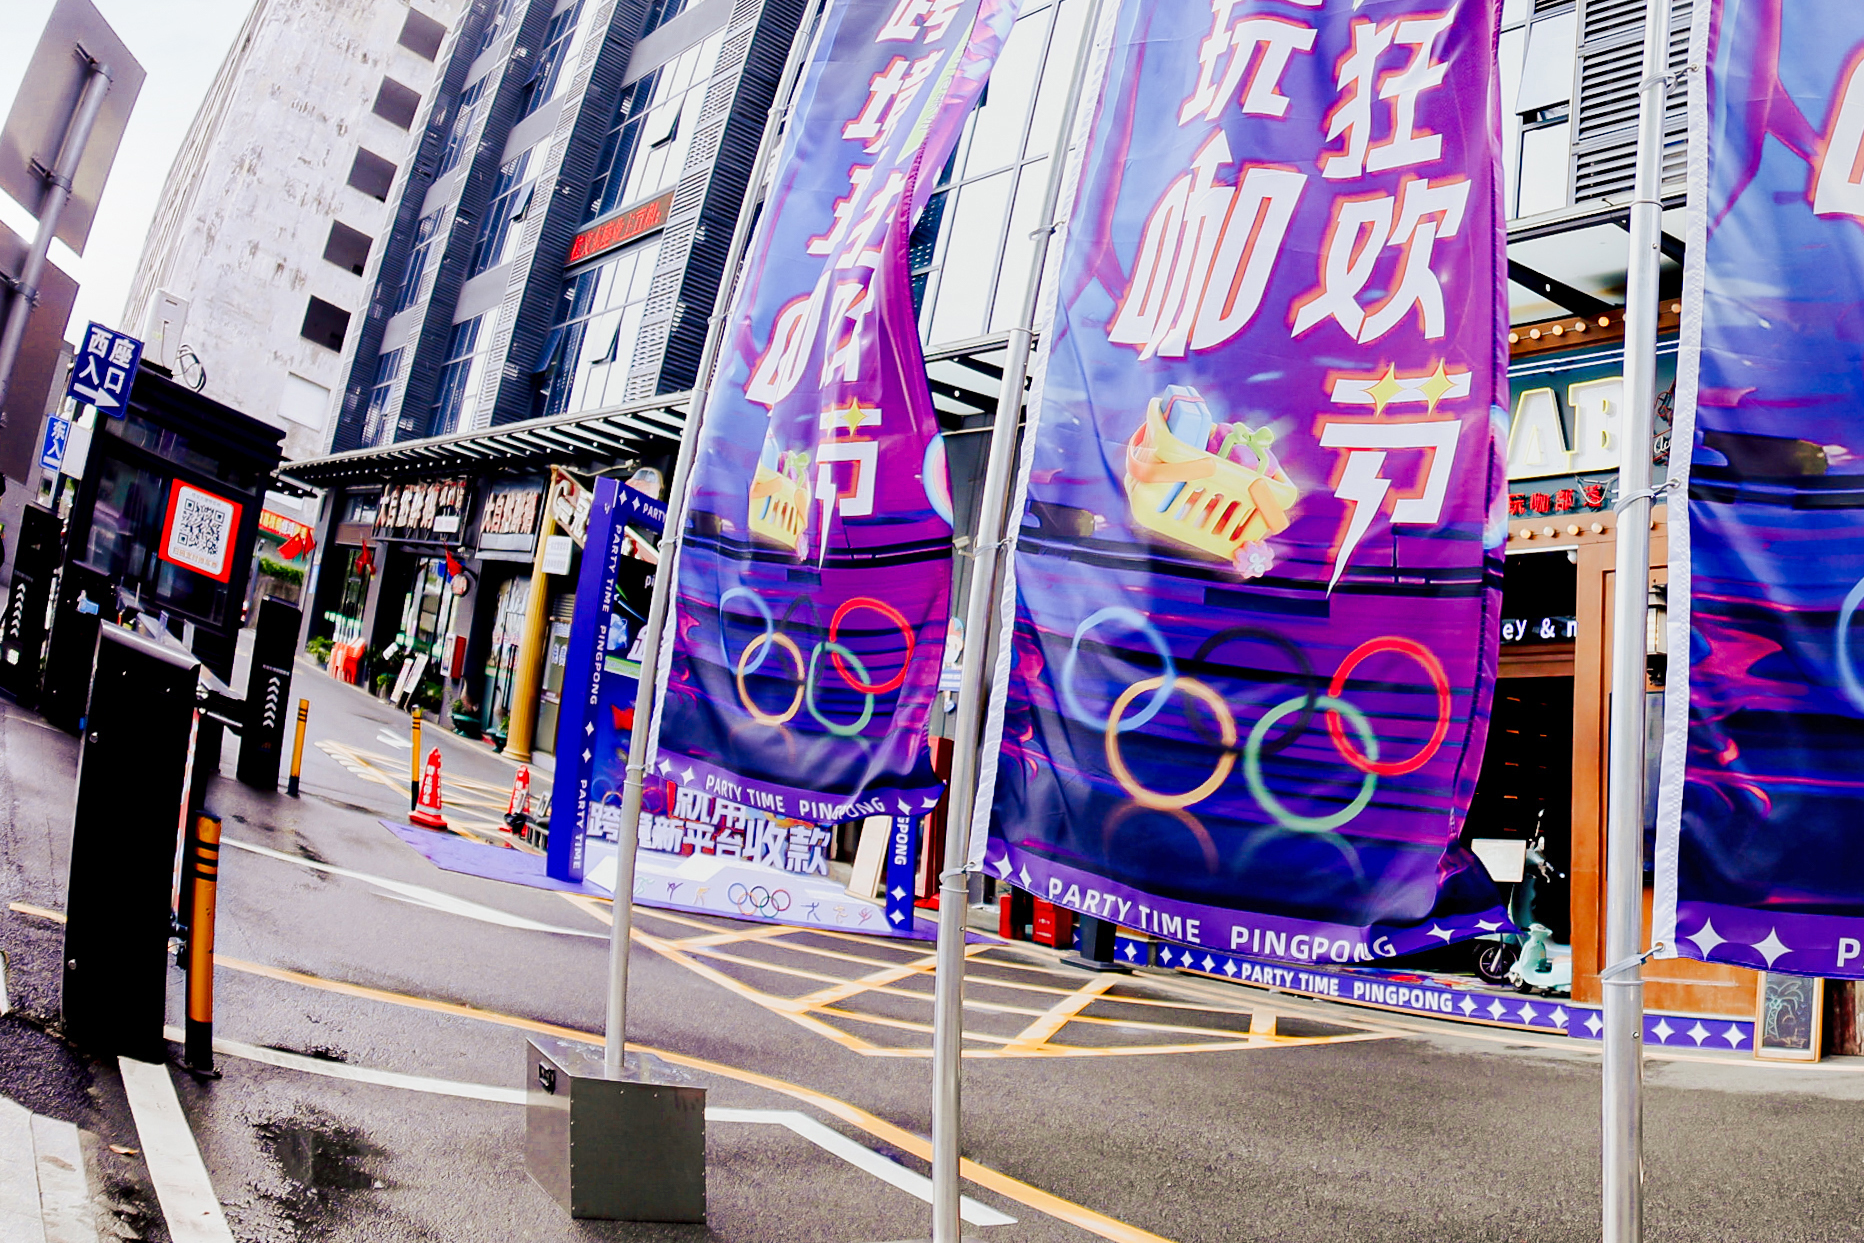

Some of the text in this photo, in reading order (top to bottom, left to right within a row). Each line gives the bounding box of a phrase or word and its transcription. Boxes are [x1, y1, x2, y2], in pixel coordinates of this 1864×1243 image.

[1292, 4, 1473, 599] 狂欢节
[86, 326, 136, 369] 西座
[78, 354, 126, 395] 入口
[1507, 376, 1625, 481] AB
[607, 524, 623, 574] PARTY
[601, 577, 615, 613] TIME
[589, 624, 607, 706] PINGPONG
[705, 774, 743, 802] PARTY
[746, 789, 785, 813] TIME
[894, 816, 911, 866] GPONG
[1046, 876, 1133, 920] PARTY
[1138, 905, 1201, 945] TIME
[1241, 963, 1454, 1014] PARTY TIME PINGPONG
